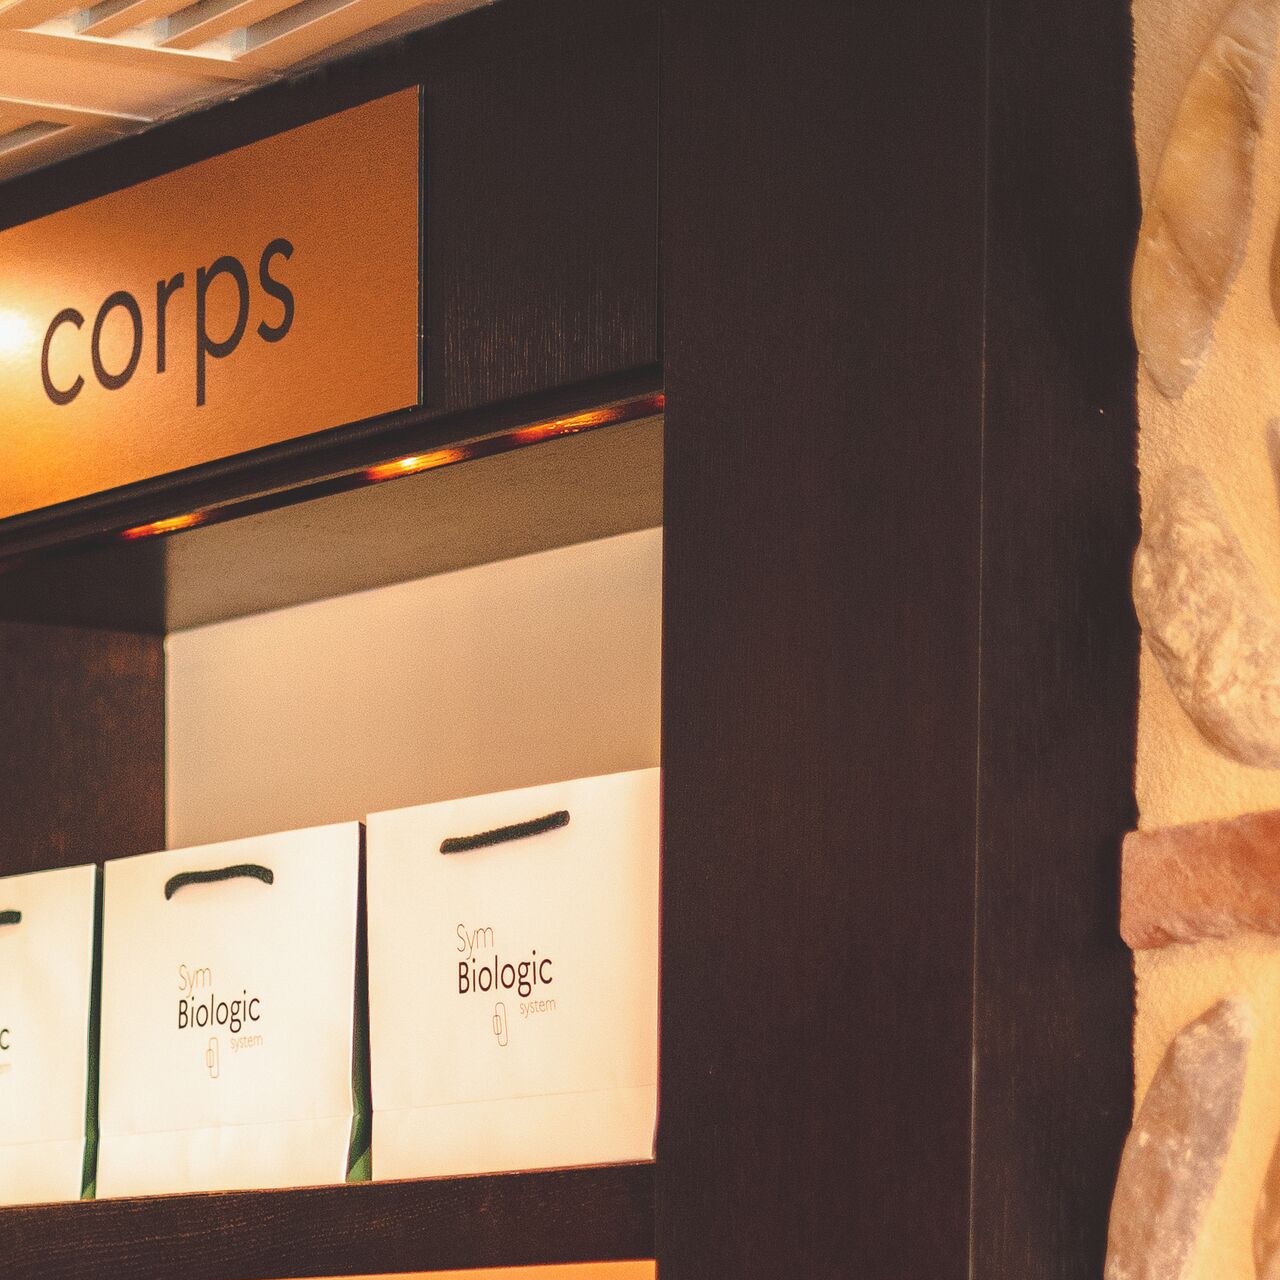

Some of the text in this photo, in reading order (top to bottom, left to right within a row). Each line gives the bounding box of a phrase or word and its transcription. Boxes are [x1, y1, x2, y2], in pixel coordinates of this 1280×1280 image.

[39, 237, 296, 407] corps
[455, 922, 494, 961] Sym
[177, 963, 212, 998] Sym
[457, 949, 553, 998] Biologic
[177, 989, 261, 1034] Biologic
[519, 998, 557, 1019] system
[229, 1033, 264, 1054] system
